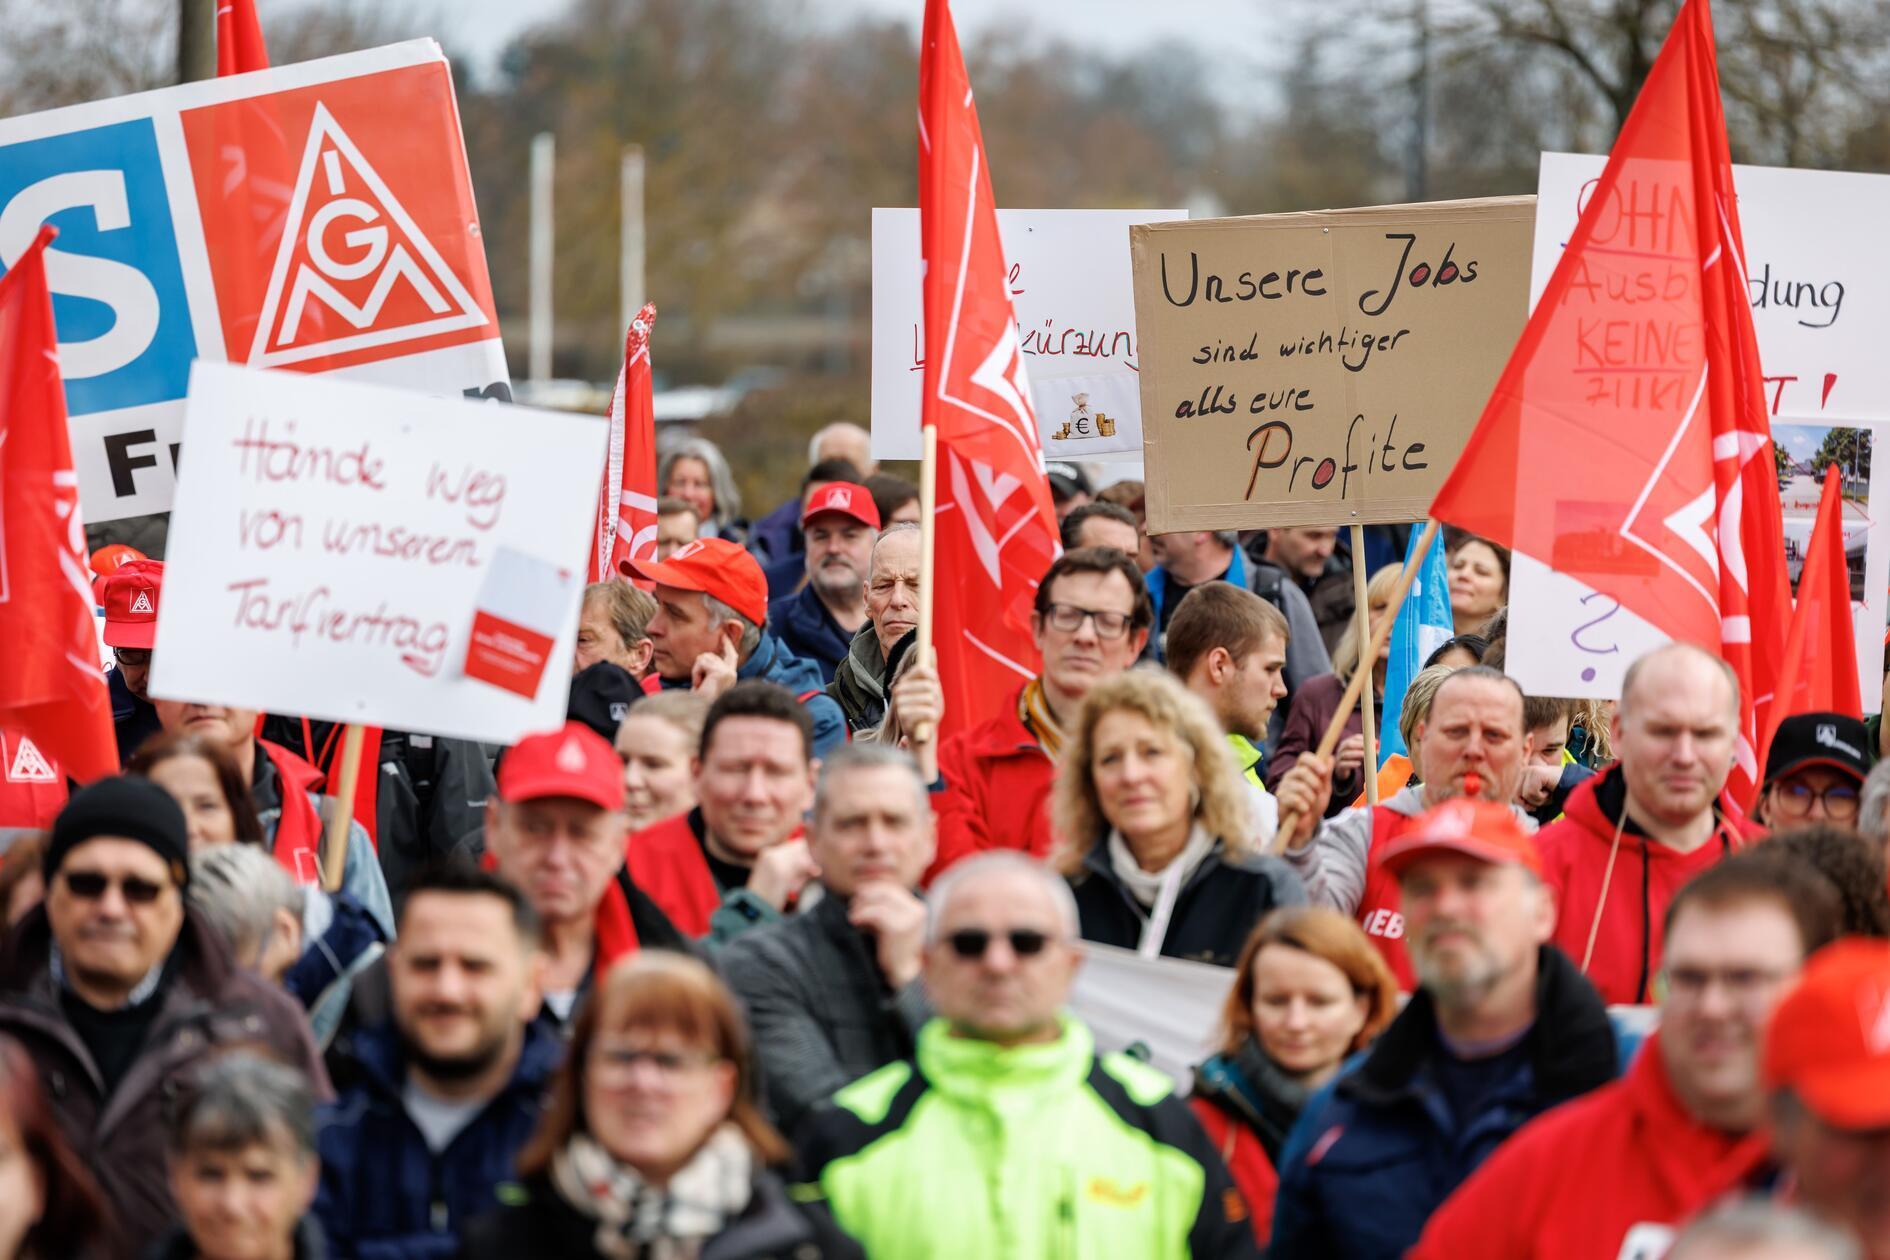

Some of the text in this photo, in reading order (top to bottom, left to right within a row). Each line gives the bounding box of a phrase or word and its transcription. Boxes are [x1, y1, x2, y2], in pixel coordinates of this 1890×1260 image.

[1577, 178, 1698, 253] OHN
[1160, 233, 1478, 316] Unsere Jobs
[1192, 326, 1410, 372] sind wichtiger
[1576, 317, 1701, 368] KEINE
[1174, 384, 1315, 418] alls eure
[232, 417, 386, 490] Hände
[1243, 413, 1428, 500] Profite
